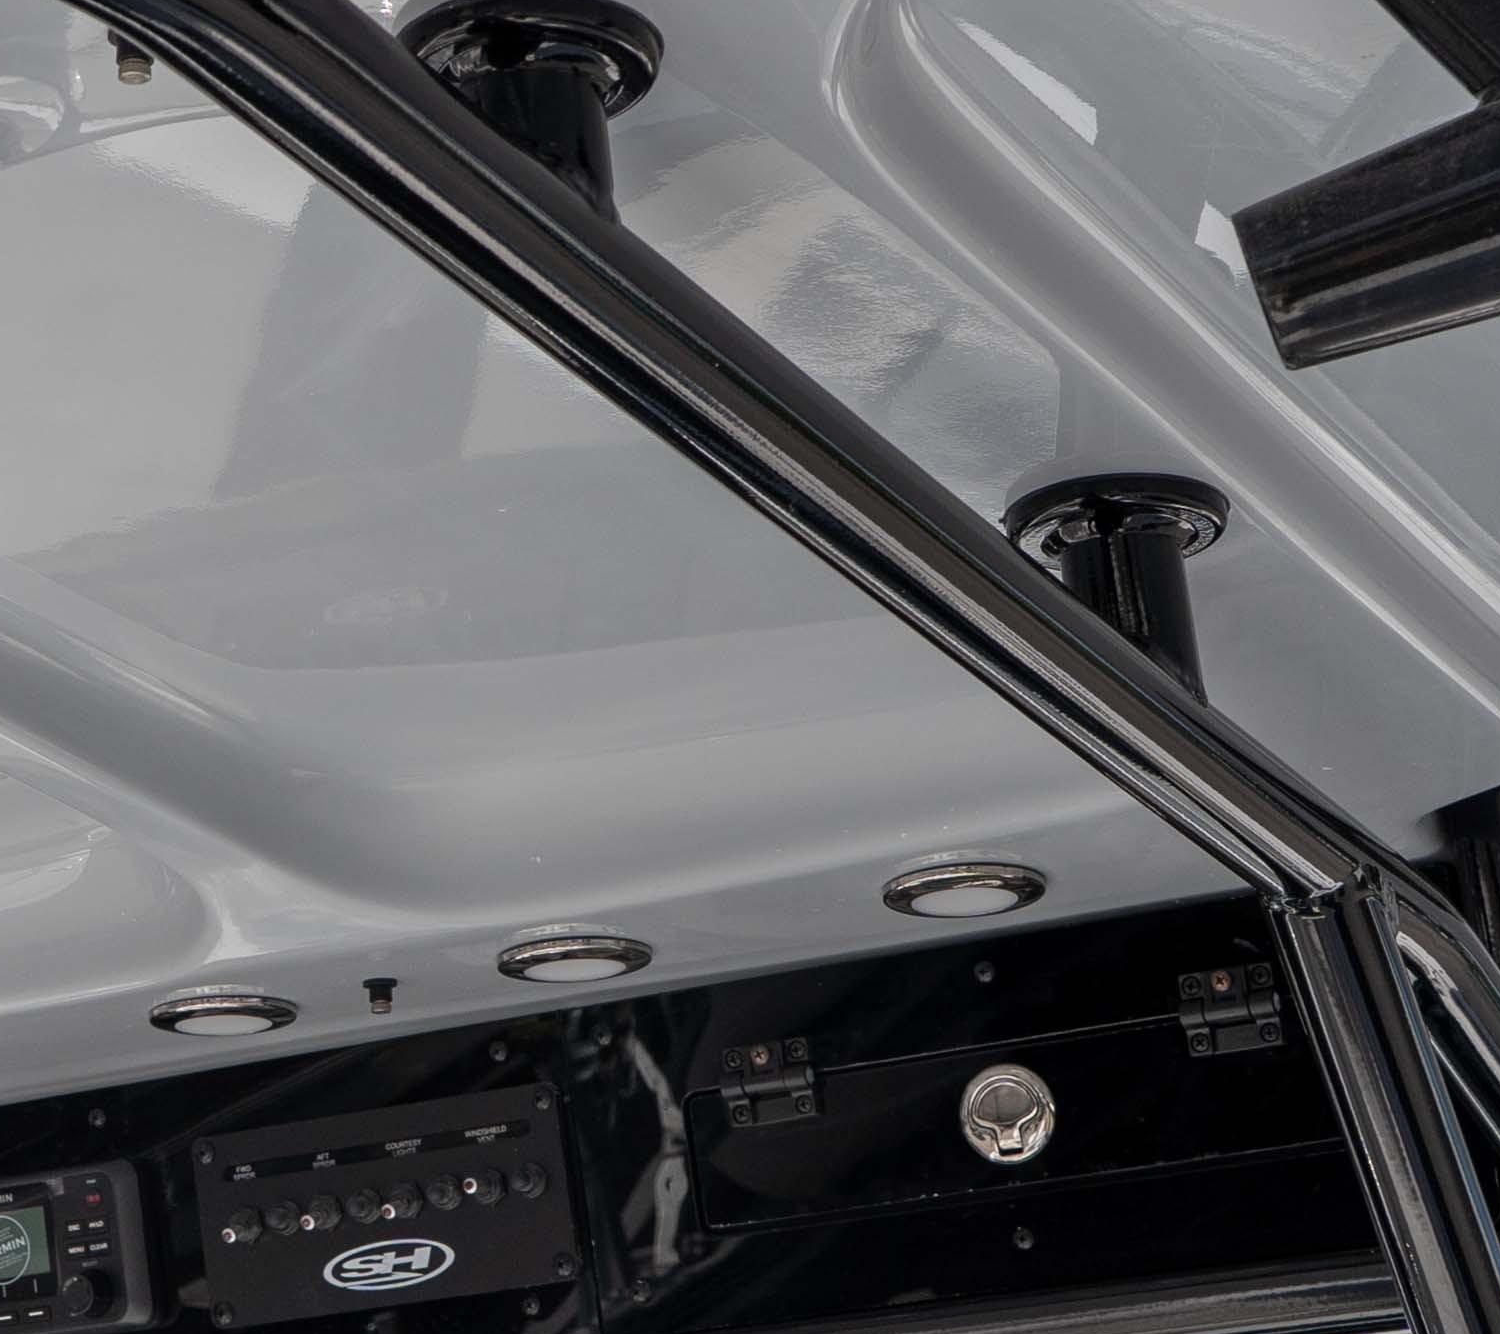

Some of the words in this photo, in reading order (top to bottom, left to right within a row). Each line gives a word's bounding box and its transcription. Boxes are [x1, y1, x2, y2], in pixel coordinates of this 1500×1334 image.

[464, 1125, 508, 1138] WINDSHIELD
[385, 1138, 422, 1151] COURTESY
[316, 1152, 330, 1161] AFT
[68, 1246, 85, 1254] MENU
